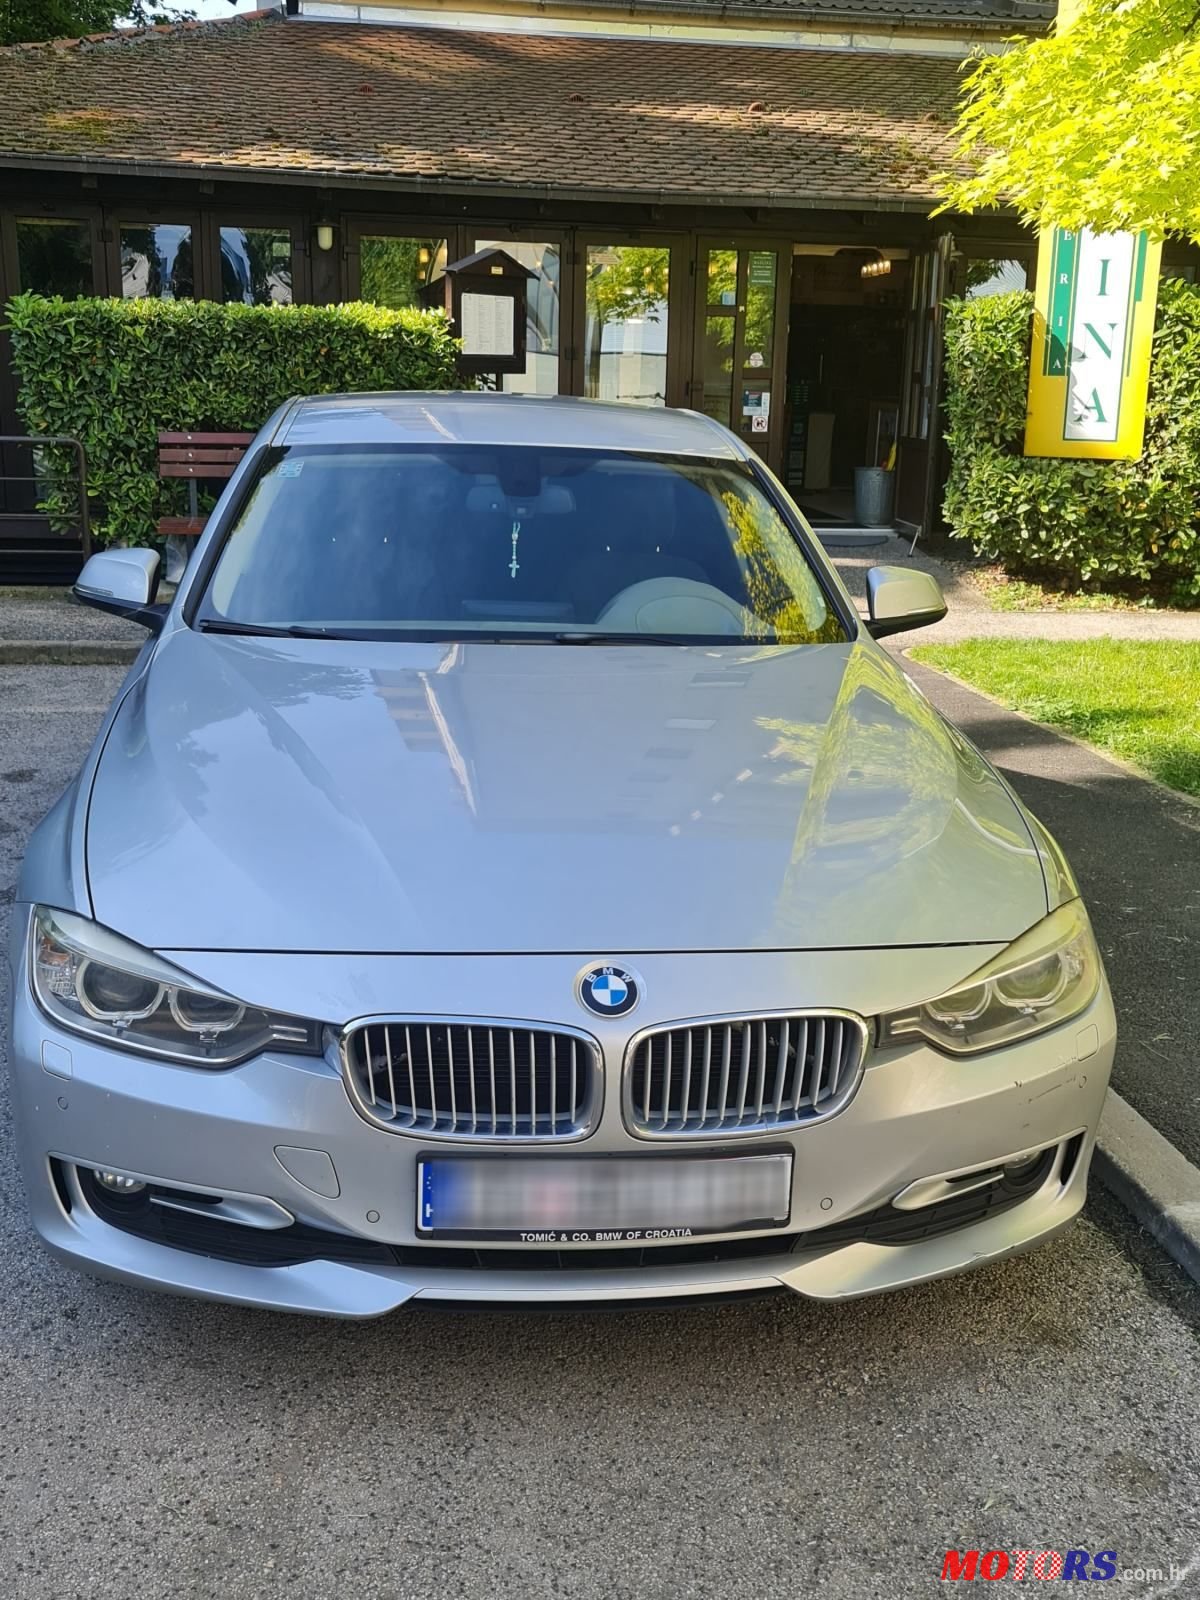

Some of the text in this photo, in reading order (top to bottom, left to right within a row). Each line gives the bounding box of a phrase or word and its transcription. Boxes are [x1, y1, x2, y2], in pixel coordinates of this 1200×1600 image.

[585, 967, 633, 983] BMW
[520, 1228, 692, 1242] TOMIĆ & CO. BMW OF CROATIA
